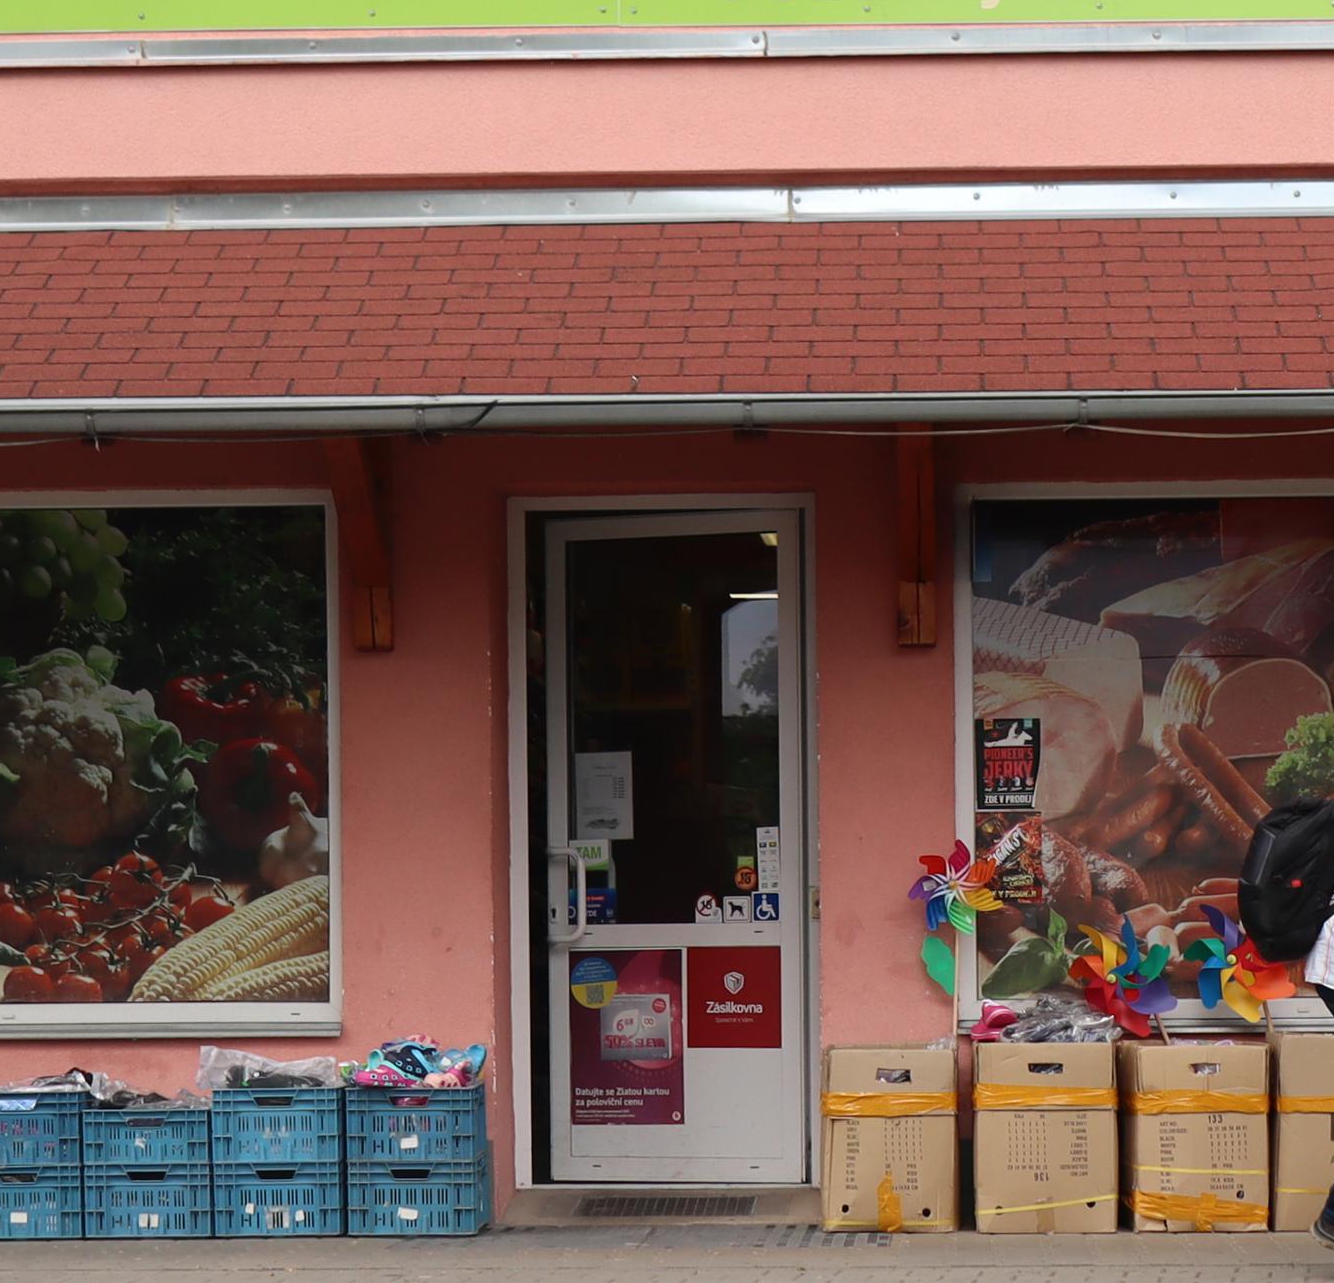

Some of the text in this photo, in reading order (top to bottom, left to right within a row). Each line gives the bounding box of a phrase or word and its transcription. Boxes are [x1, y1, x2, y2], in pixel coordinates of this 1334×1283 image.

[984, 748, 1034, 760] PIONEER'S
[984, 760, 1033, 778] JERKY
[984, 795, 998, 804] ZDE
[706, 1001, 763, 1014] Zásilkovna
[617, 1019, 624, 1031] 6
